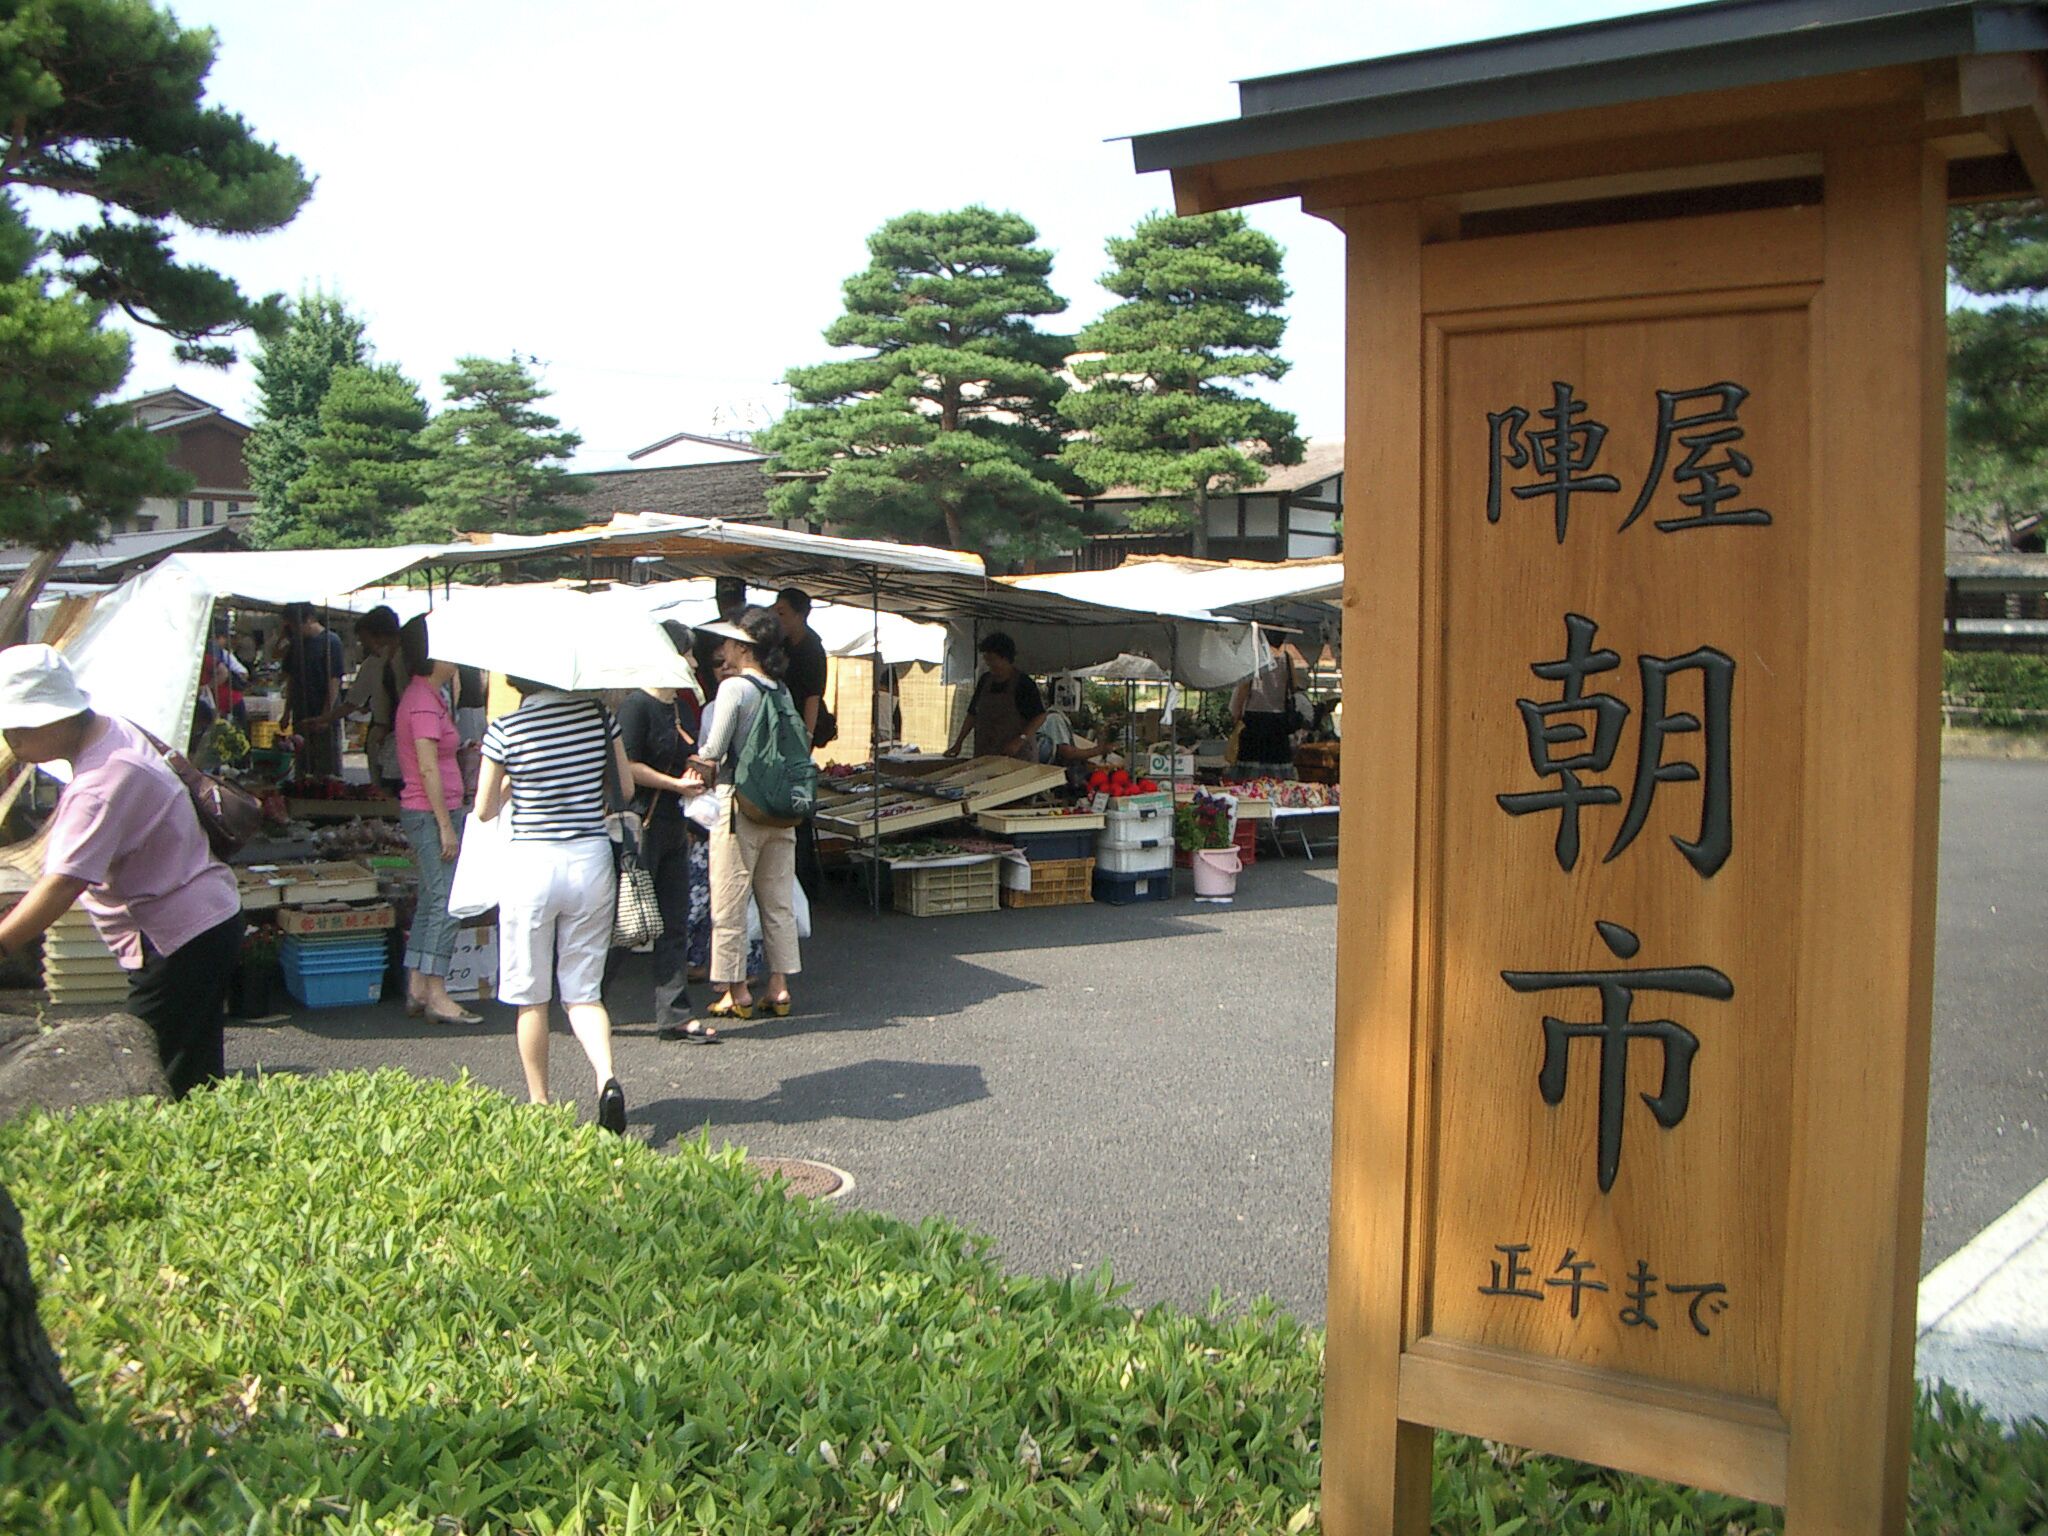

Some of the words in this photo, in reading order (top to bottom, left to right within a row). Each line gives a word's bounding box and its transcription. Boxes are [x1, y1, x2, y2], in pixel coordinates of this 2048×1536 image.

[1486, 380, 1773, 544] 陣屋
[1496, 612, 1736, 1194] 朝市
[1478, 1243, 1729, 1336] 正午まで
